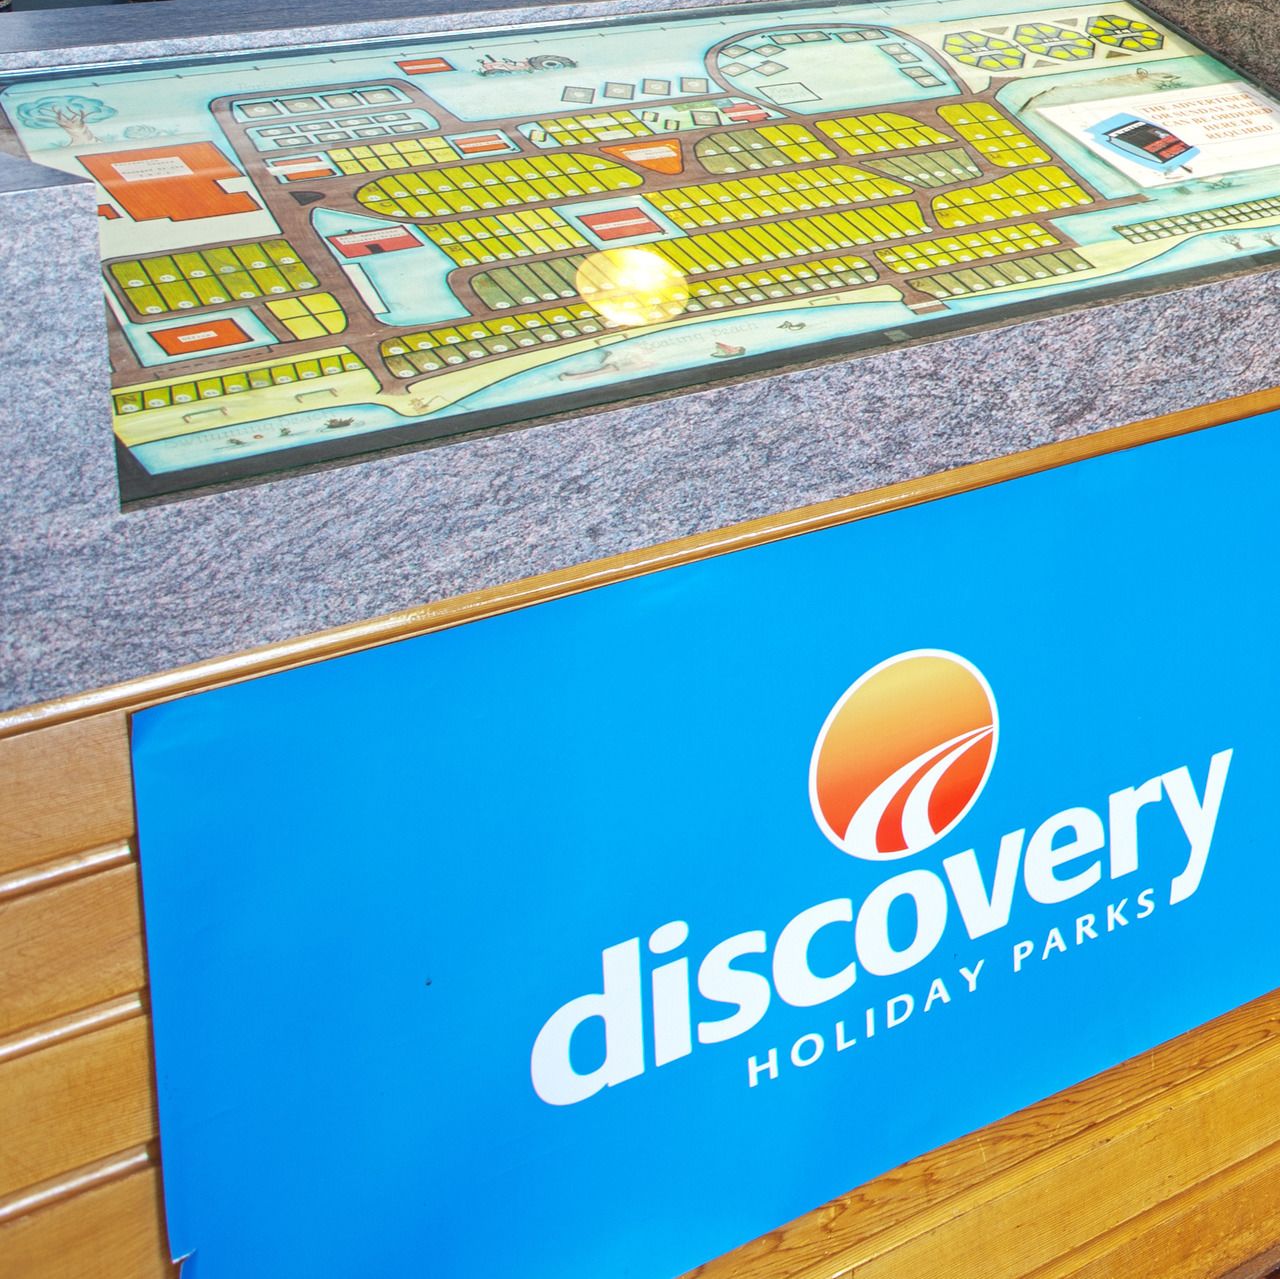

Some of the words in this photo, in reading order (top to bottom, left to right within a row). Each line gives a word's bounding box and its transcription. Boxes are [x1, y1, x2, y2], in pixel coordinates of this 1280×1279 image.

[1142, 105, 1167, 113] THE
[1173, 93, 1252, 110] ADVERTISER
[1174, 105, 1225, 118] SUNDAY
[1229, 101, 1263, 111] MAIL
[1162, 119, 1190, 127] CAN
[1195, 116, 1211, 125] BE
[1215, 108, 1273, 121] ORDERED
[1203, 121, 1234, 131] HERE
[1205, 125, 1273, 140] REQUIRED
[530, 748, 1234, 1106] discovery
[748, 959, 984, 1088] HOLIDAY
[1012, 887, 1158, 974] PARKS
